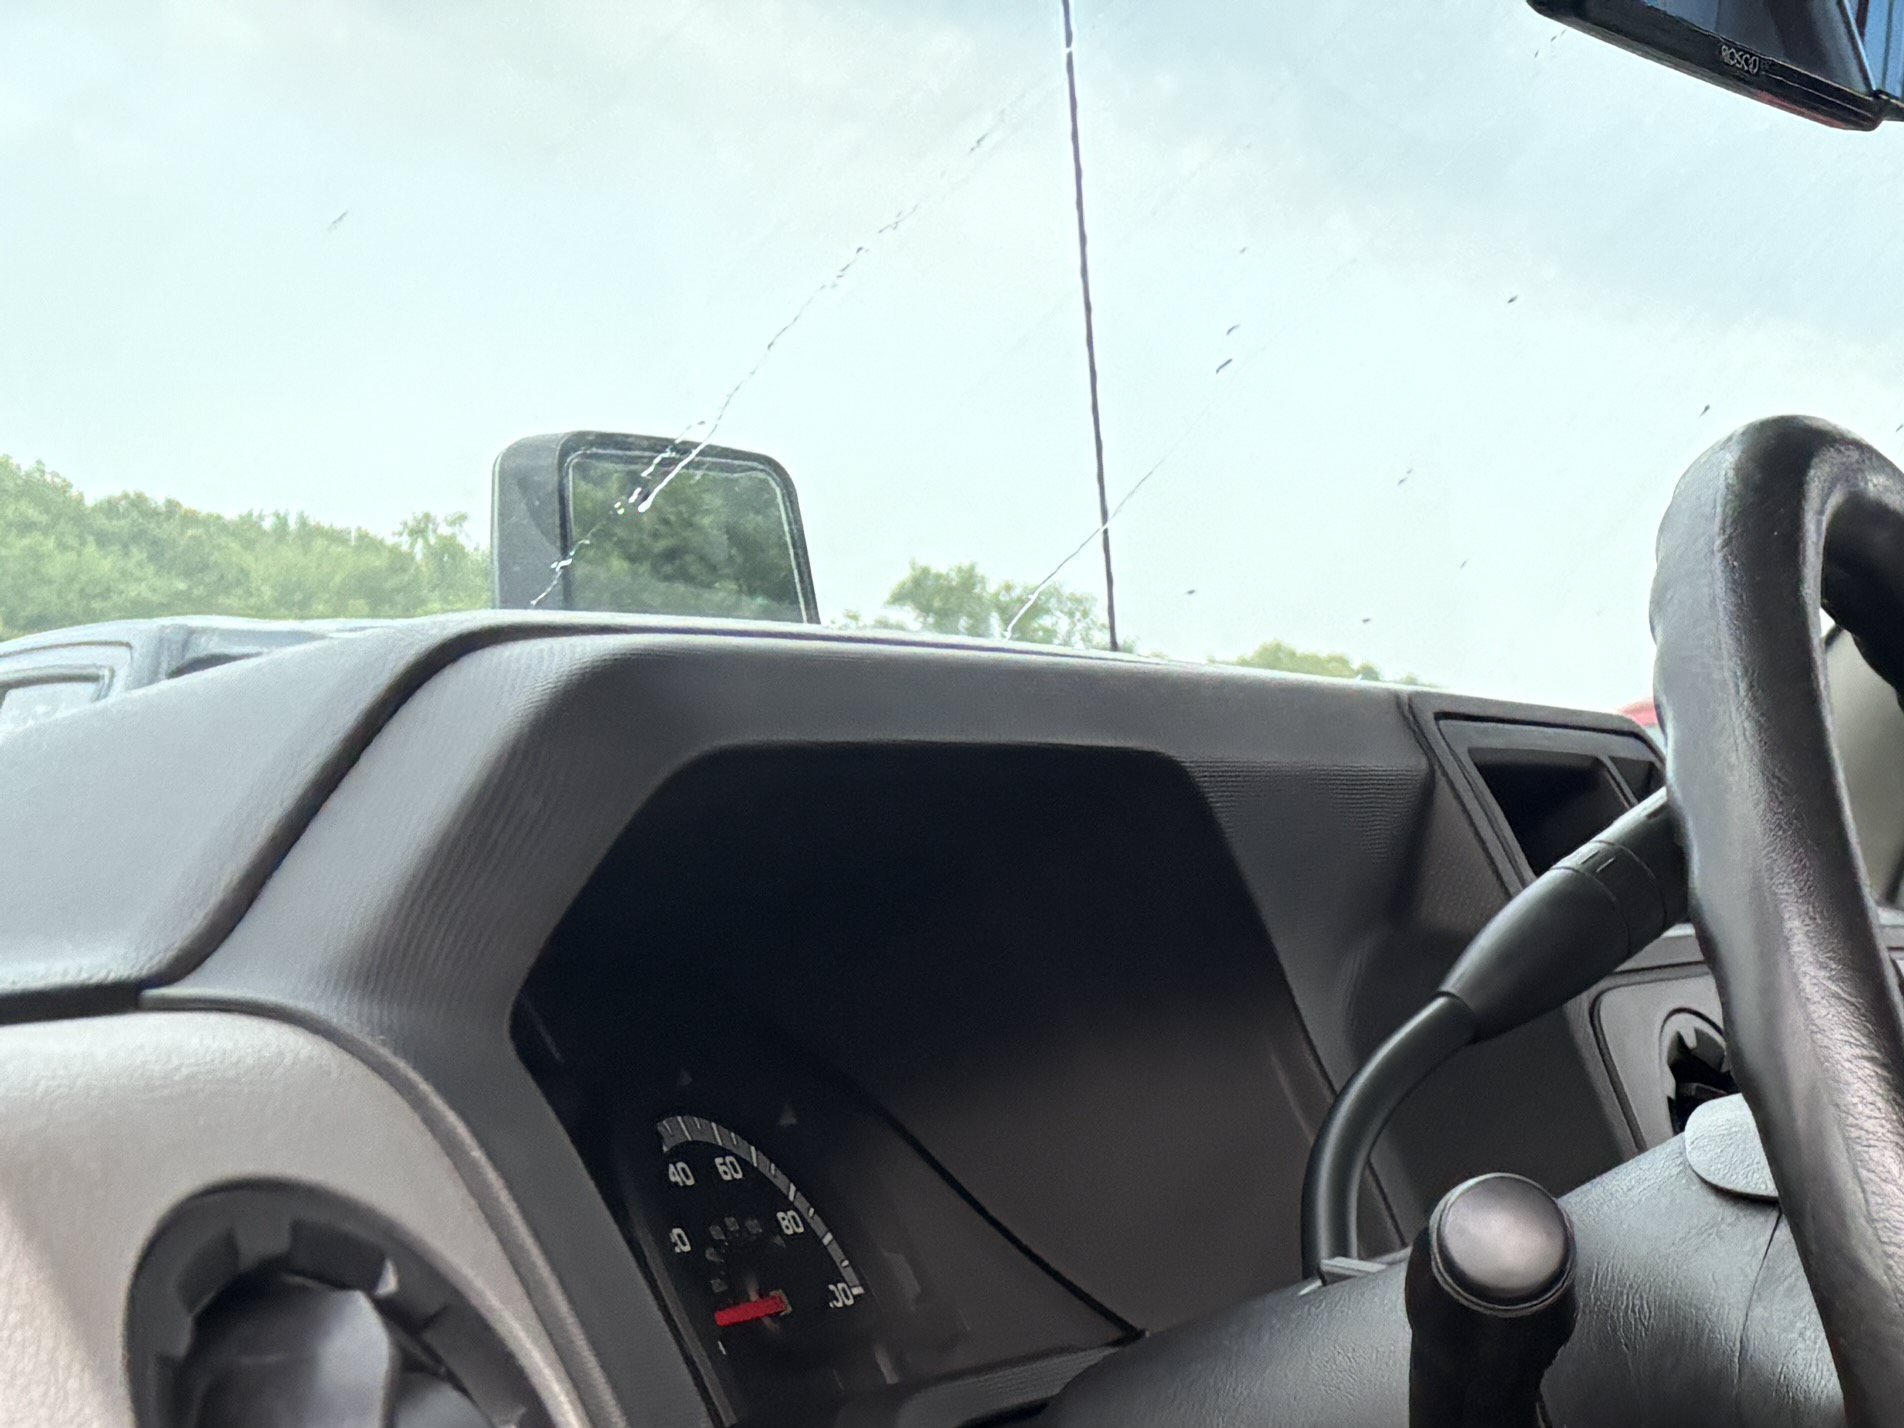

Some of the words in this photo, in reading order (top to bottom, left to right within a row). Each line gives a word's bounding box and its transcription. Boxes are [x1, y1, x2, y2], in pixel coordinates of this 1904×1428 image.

[1720, 44, 1760, 74] ROSCO
[668, 1161, 695, 1186] 40
[714, 1156, 743, 1180] 60
[776, 1210, 804, 1235] 80
